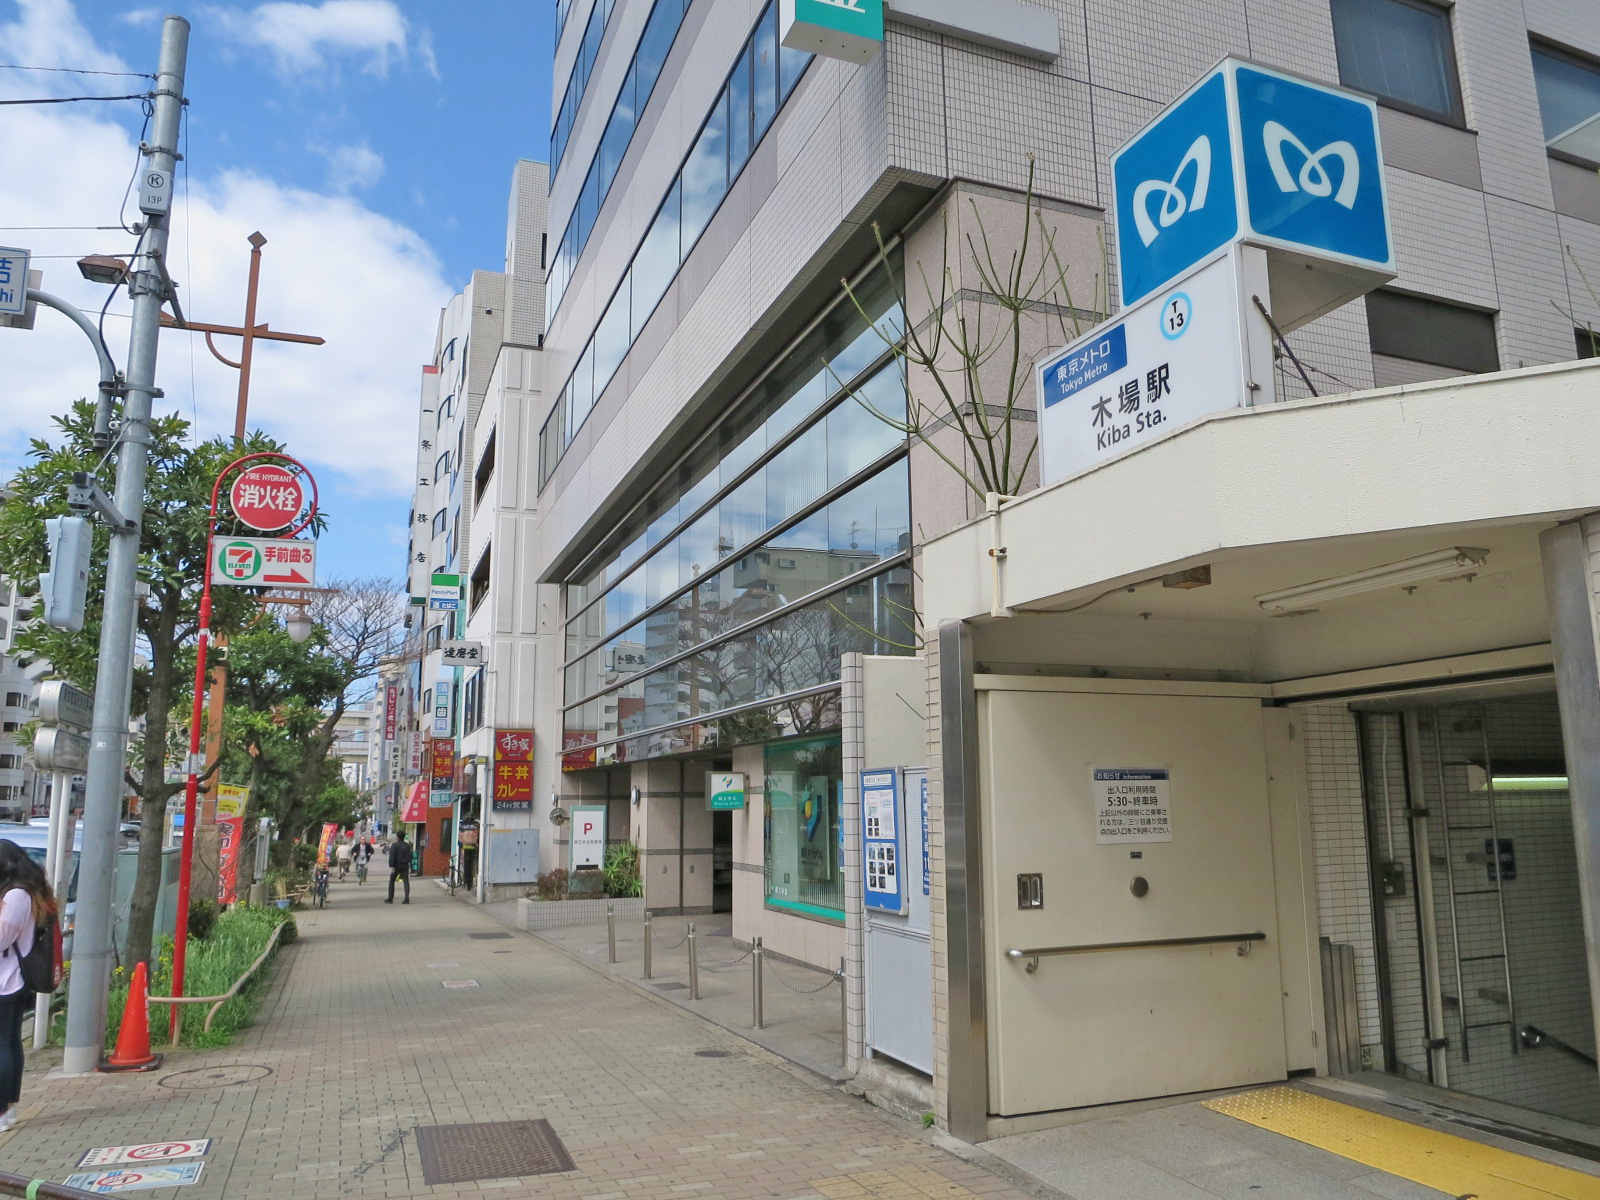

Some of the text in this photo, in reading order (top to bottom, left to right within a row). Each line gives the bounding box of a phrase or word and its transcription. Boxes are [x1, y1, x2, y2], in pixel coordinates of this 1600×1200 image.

[147, 195, 163, 204] 13P
[1171, 301, 1179, 314] T
[1169, 312, 1185, 331] 13
[1056, 339, 1111, 383] 東京メトロ
[1060, 361, 1108, 395] Tokyo Metro
[1091, 362, 1171, 428] 木場駅
[1096, 408, 1167, 452] Kiba Sta.
[245, 472, 293, 483] FIRE HYDRANT
[238, 483, 298, 511] 消火栓
[264, 546, 313, 563] 手前曲る
[444, 646, 479, 659] 達磨堂
[501, 732, 530, 753] すき家
[434, 767, 452, 776] カレー
[498, 765, 530, 780] 牛丼
[1096, 772, 1120, 780] お知らせ
[433, 777, 447, 785] 24
[496, 782, 530, 798] カレー
[1107, 785, 1157, 795] 出入口利用時間
[496, 801, 529, 809] 24H営業
[584, 822, 593, 835] P
